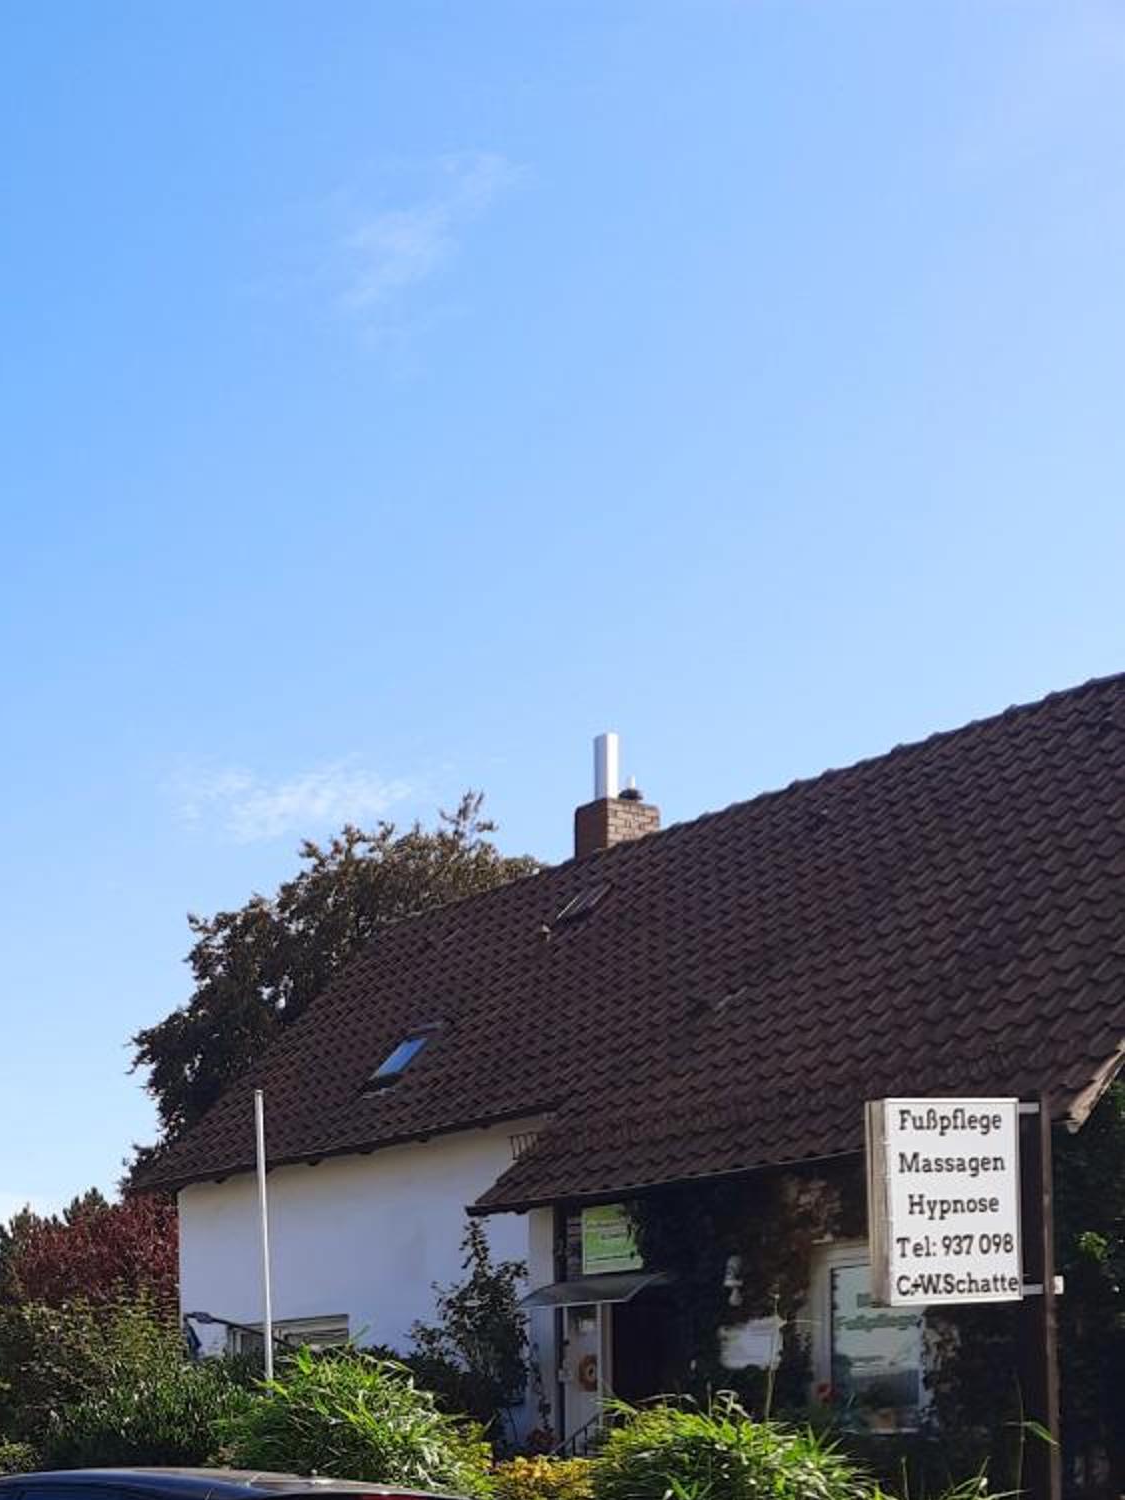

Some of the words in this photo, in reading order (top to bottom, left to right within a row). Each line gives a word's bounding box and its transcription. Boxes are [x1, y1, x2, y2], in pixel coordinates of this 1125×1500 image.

[898, 1108, 1002, 1136] Fußpflege
[898, 1152, 1005, 1177] Massagen
[908, 1194, 1000, 1220] Hypnose
[896, 1235, 937, 1258] Tel:
[942, 1234, 974, 1256] 937
[979, 1233, 1014, 1254] 098
